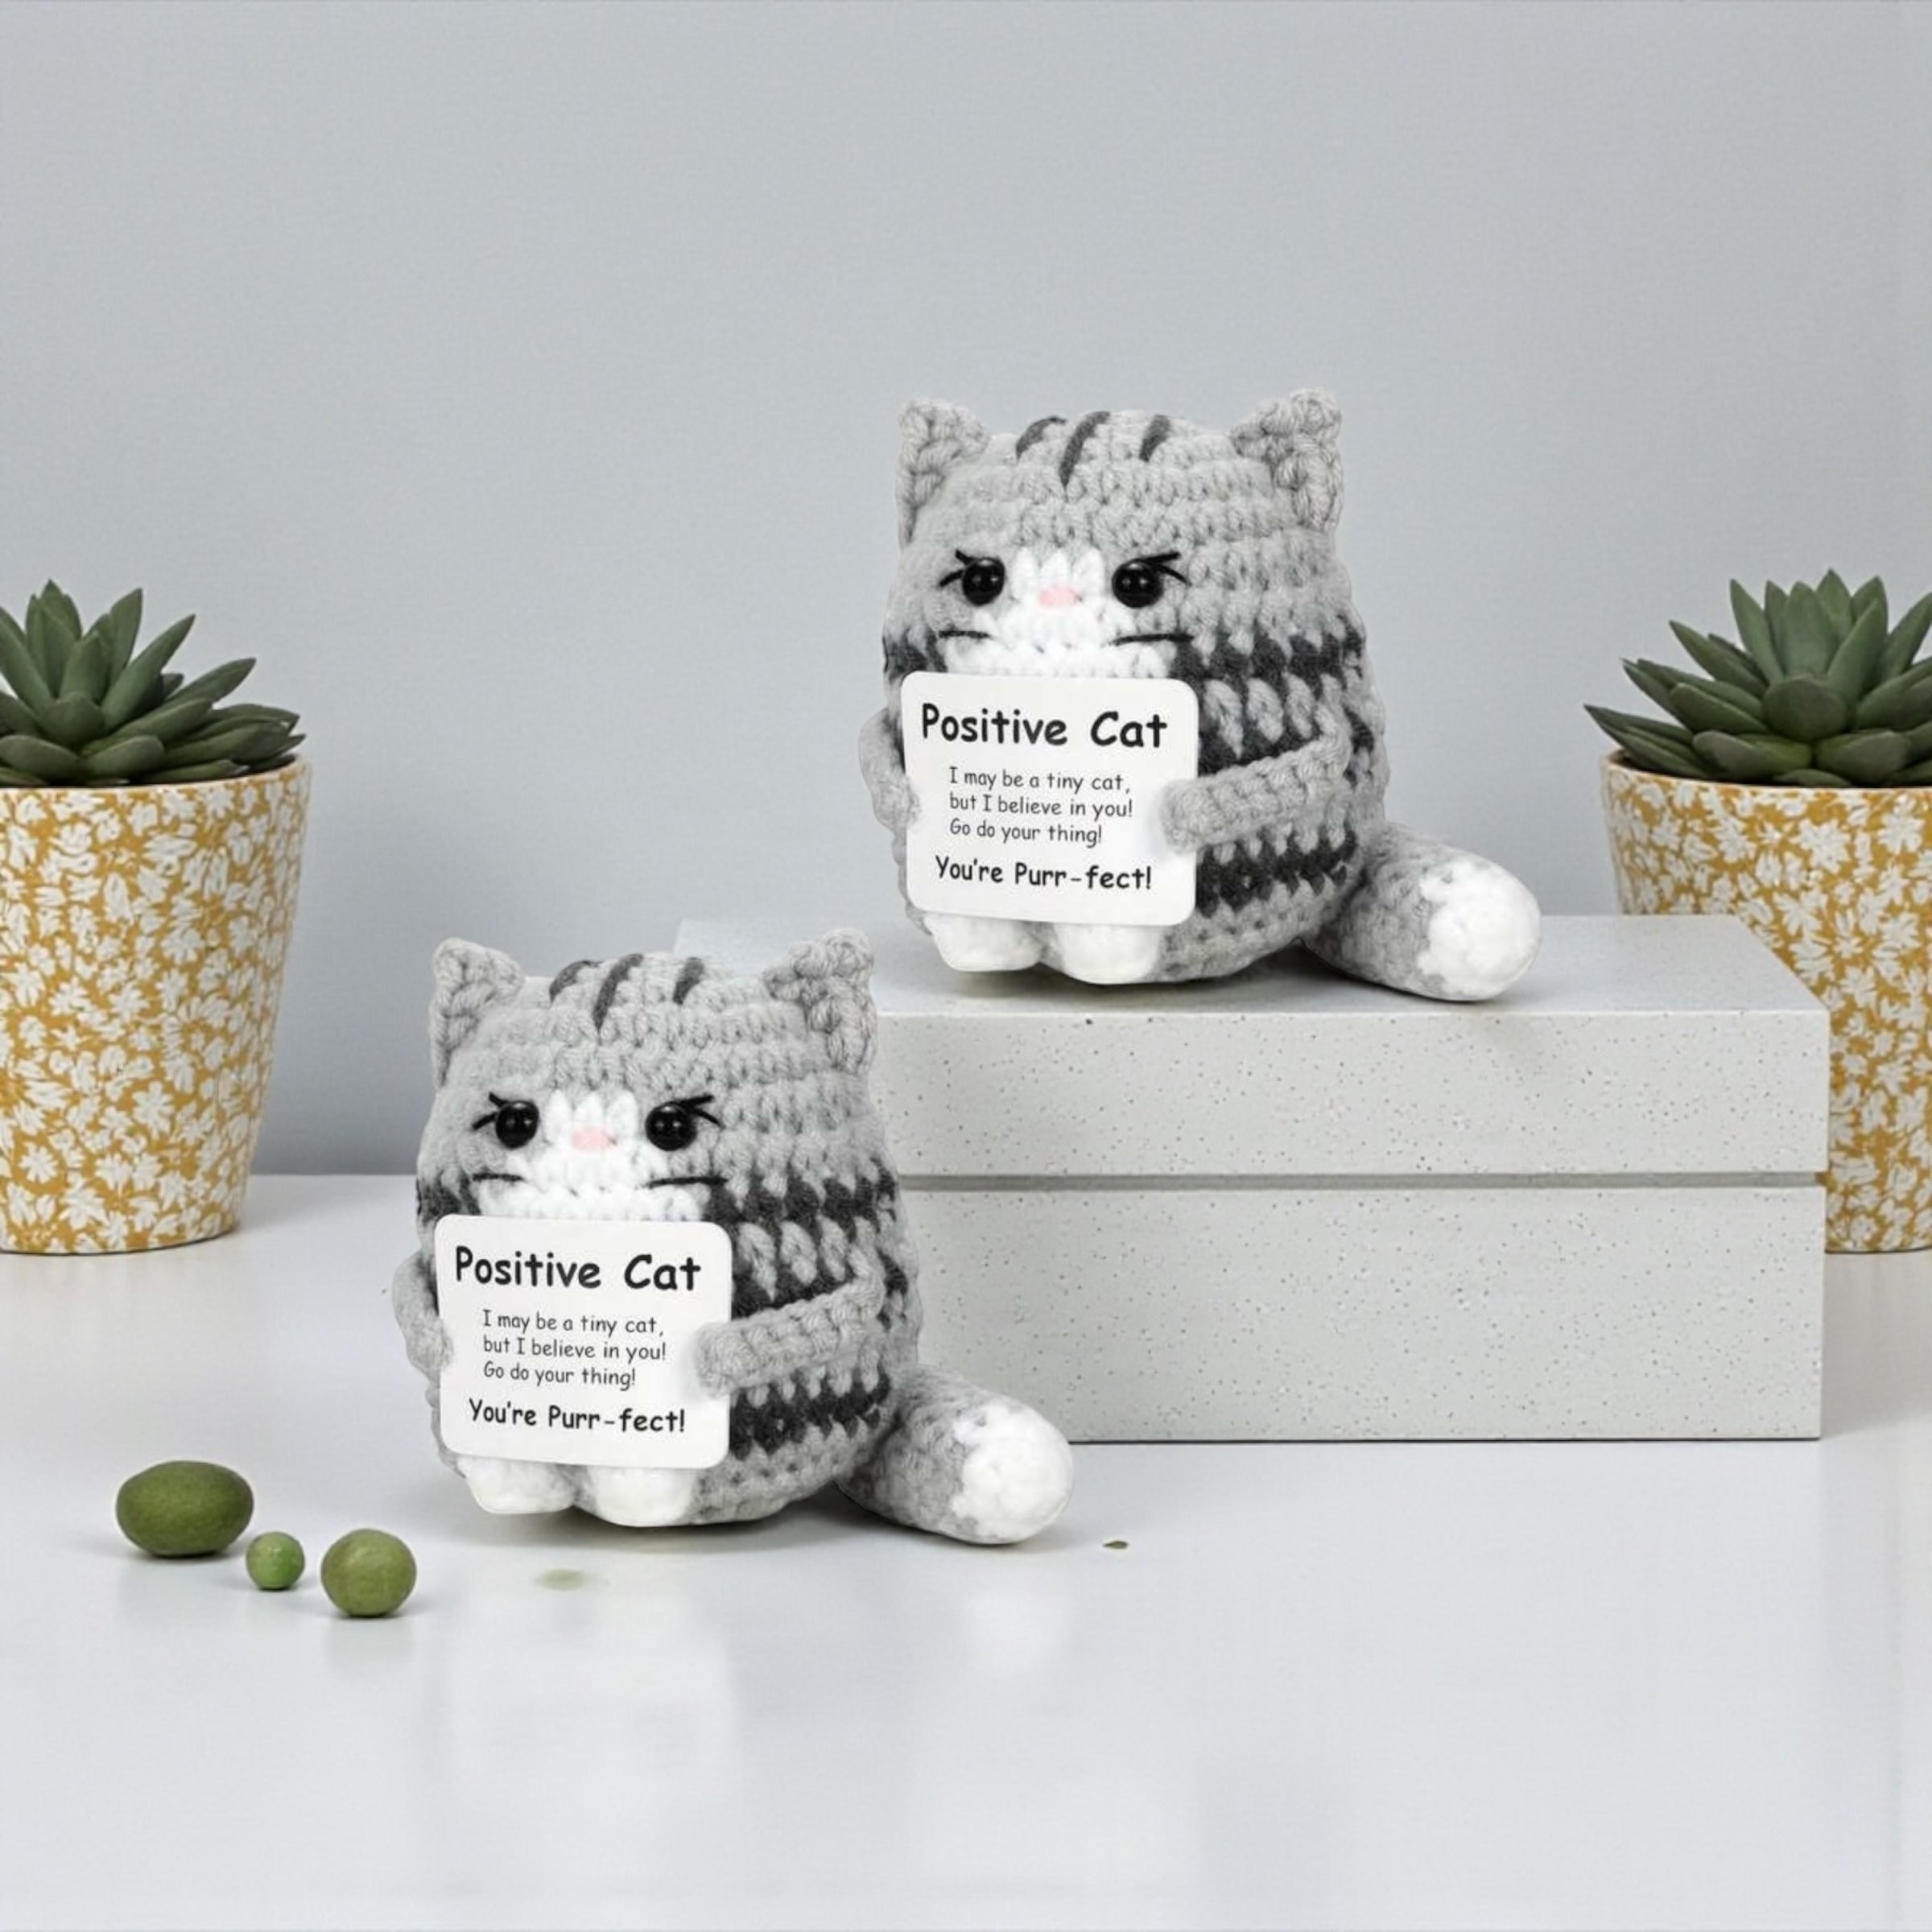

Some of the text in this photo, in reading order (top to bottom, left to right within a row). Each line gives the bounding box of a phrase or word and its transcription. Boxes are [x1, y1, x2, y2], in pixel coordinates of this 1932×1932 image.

[922, 702, 1168, 749] Positive Cat
[949, 766, 1130, 795] I may be a tiny cat,
[950, 792, 1133, 822] but I believe in you!
[949, 818, 1102, 848] Go do your thing!
[935, 855, 1151, 890] You're Purr-fect!
[456, 1245, 701, 1291] Positive Cat
[483, 1309, 664, 1338] I may be a tiny cat,
[483, 1335, 666, 1364] but I believe in you!
[483, 1360, 635, 1392] Go do your thing!
[469, 1397, 685, 1432] You're Purr-fect!
